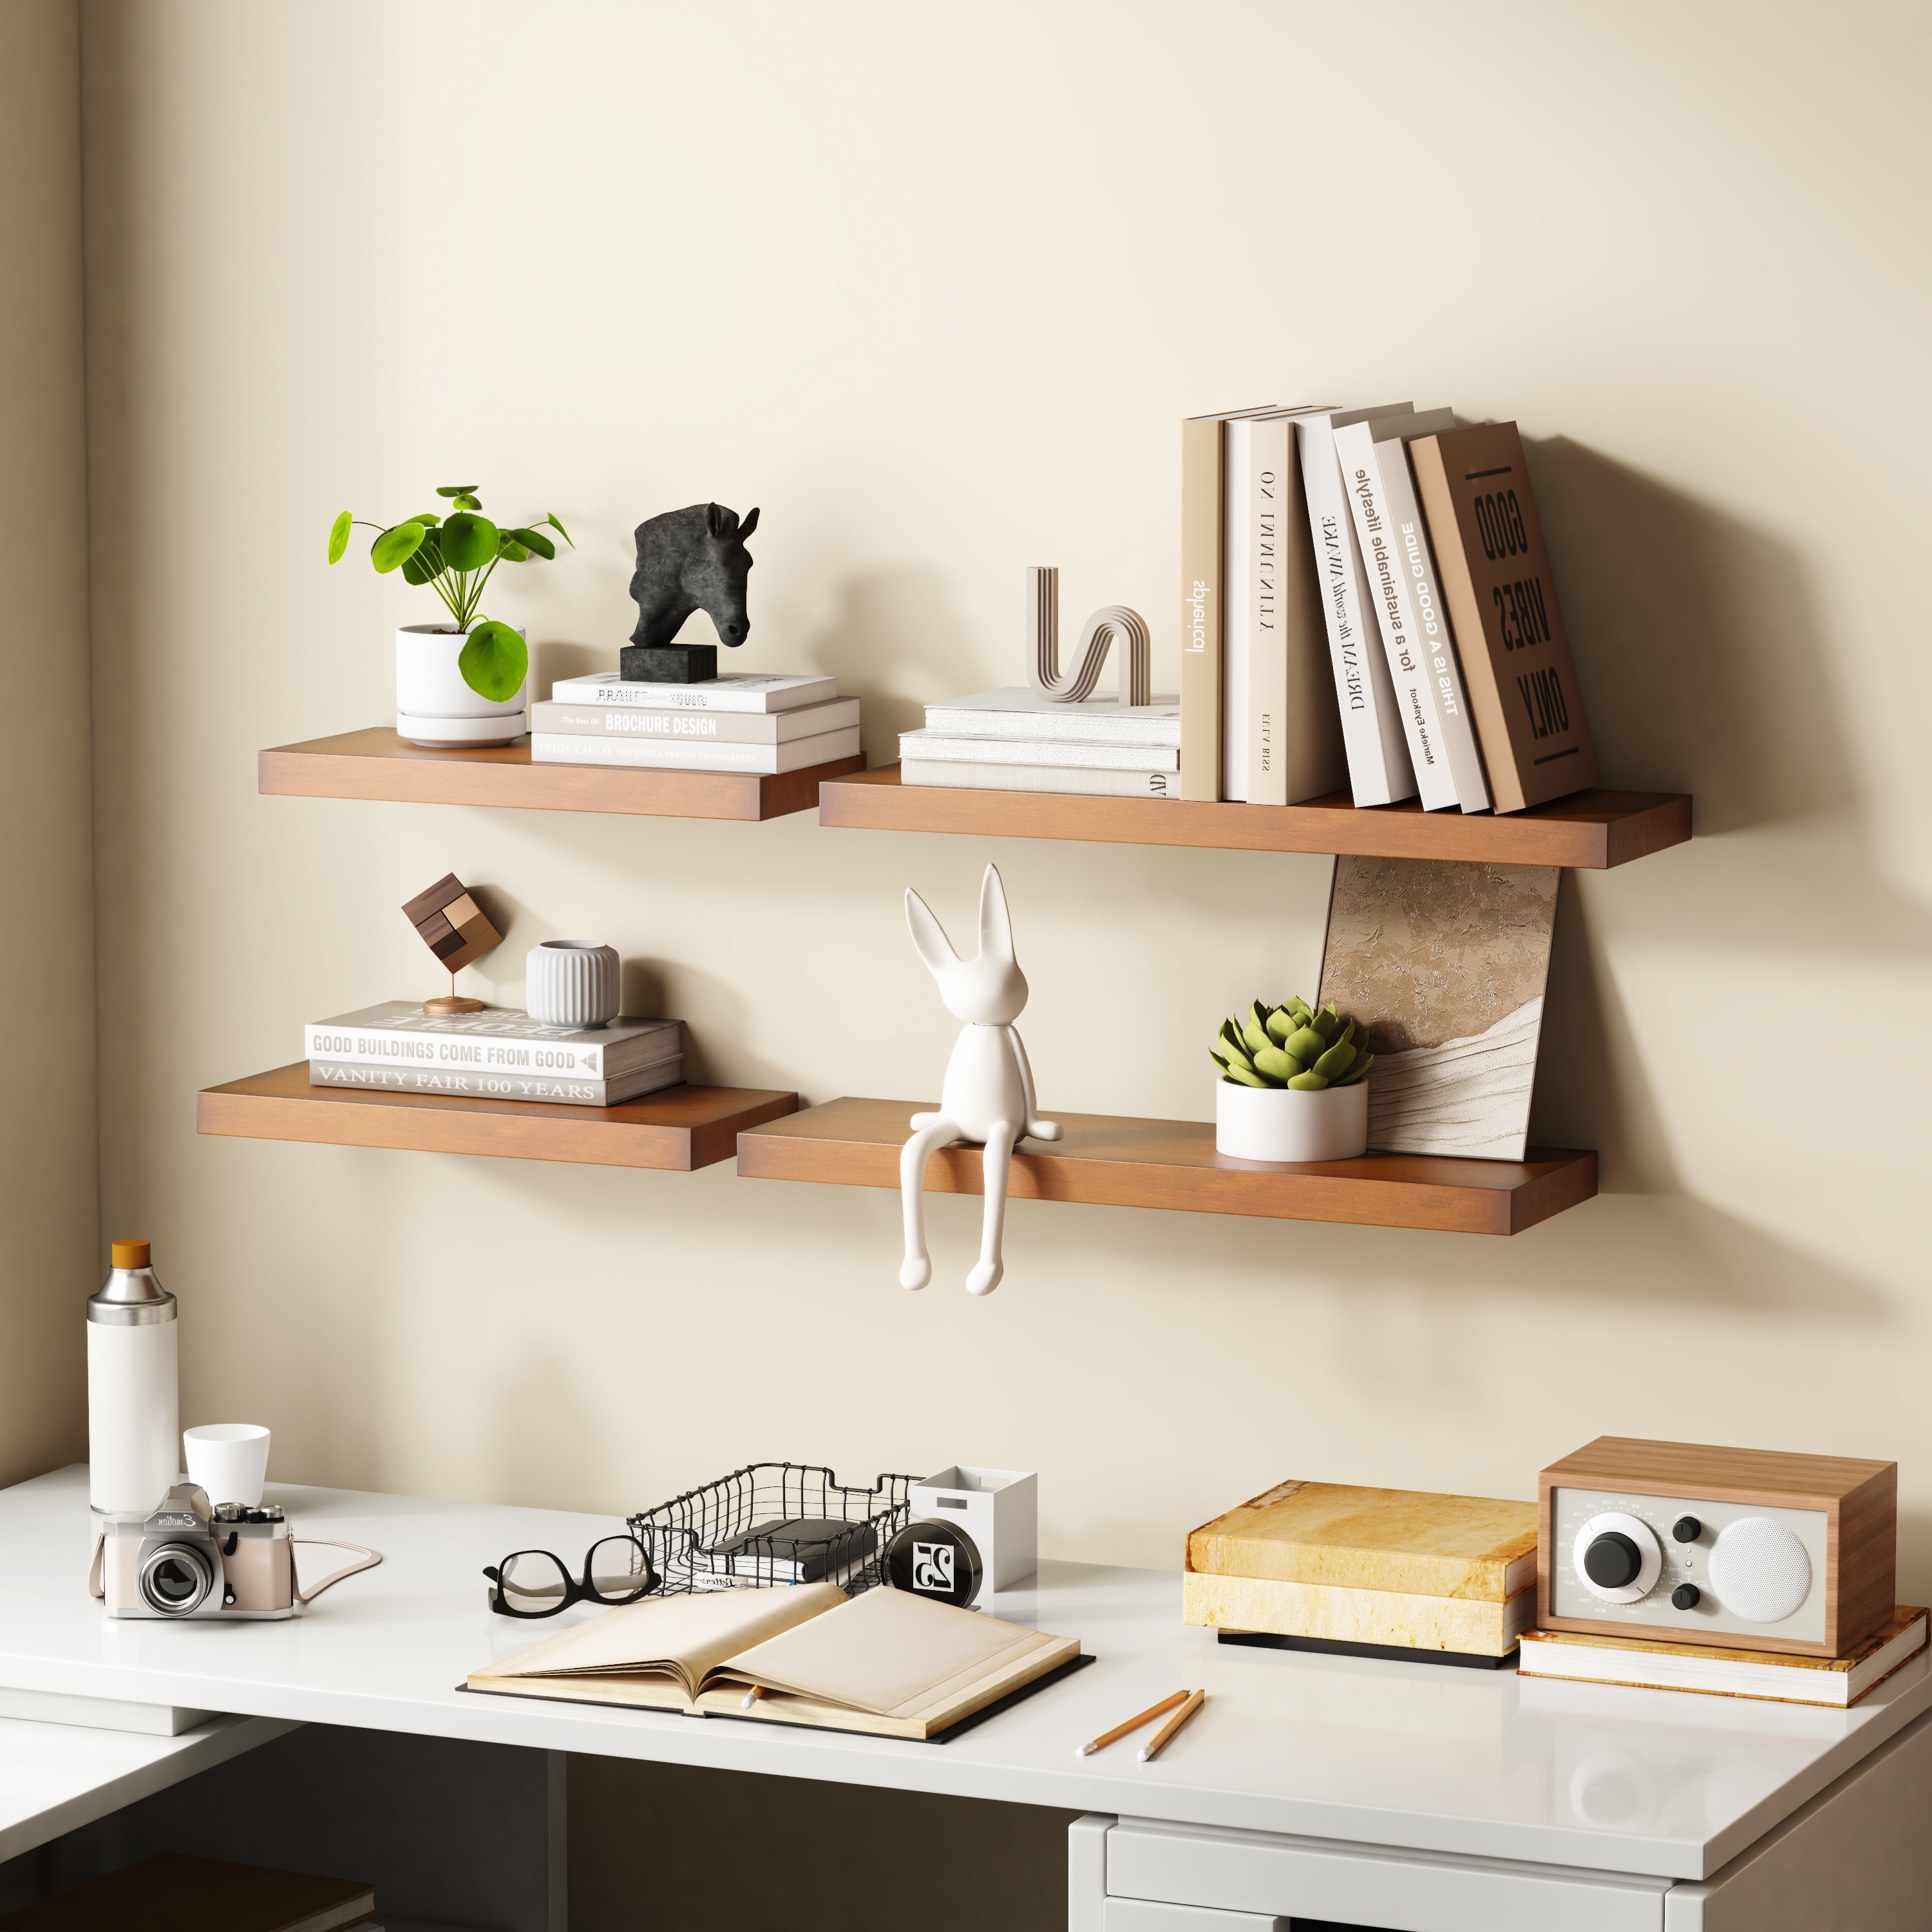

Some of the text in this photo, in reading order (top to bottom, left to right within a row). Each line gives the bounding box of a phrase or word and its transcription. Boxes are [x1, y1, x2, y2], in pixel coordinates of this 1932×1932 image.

[605, 714, 670, 734] BROCHURE
[673, 717, 716, 735] DESIGN
[539, 743, 571, 754] FRIDA
[574, 745, 611, 756] KAHLO
[314, 1035, 575, 1069] GOOD BUILDINGS COME FROM GOOD
[317, 1067, 594, 1099] VANITY FAIR 100 YEARS
